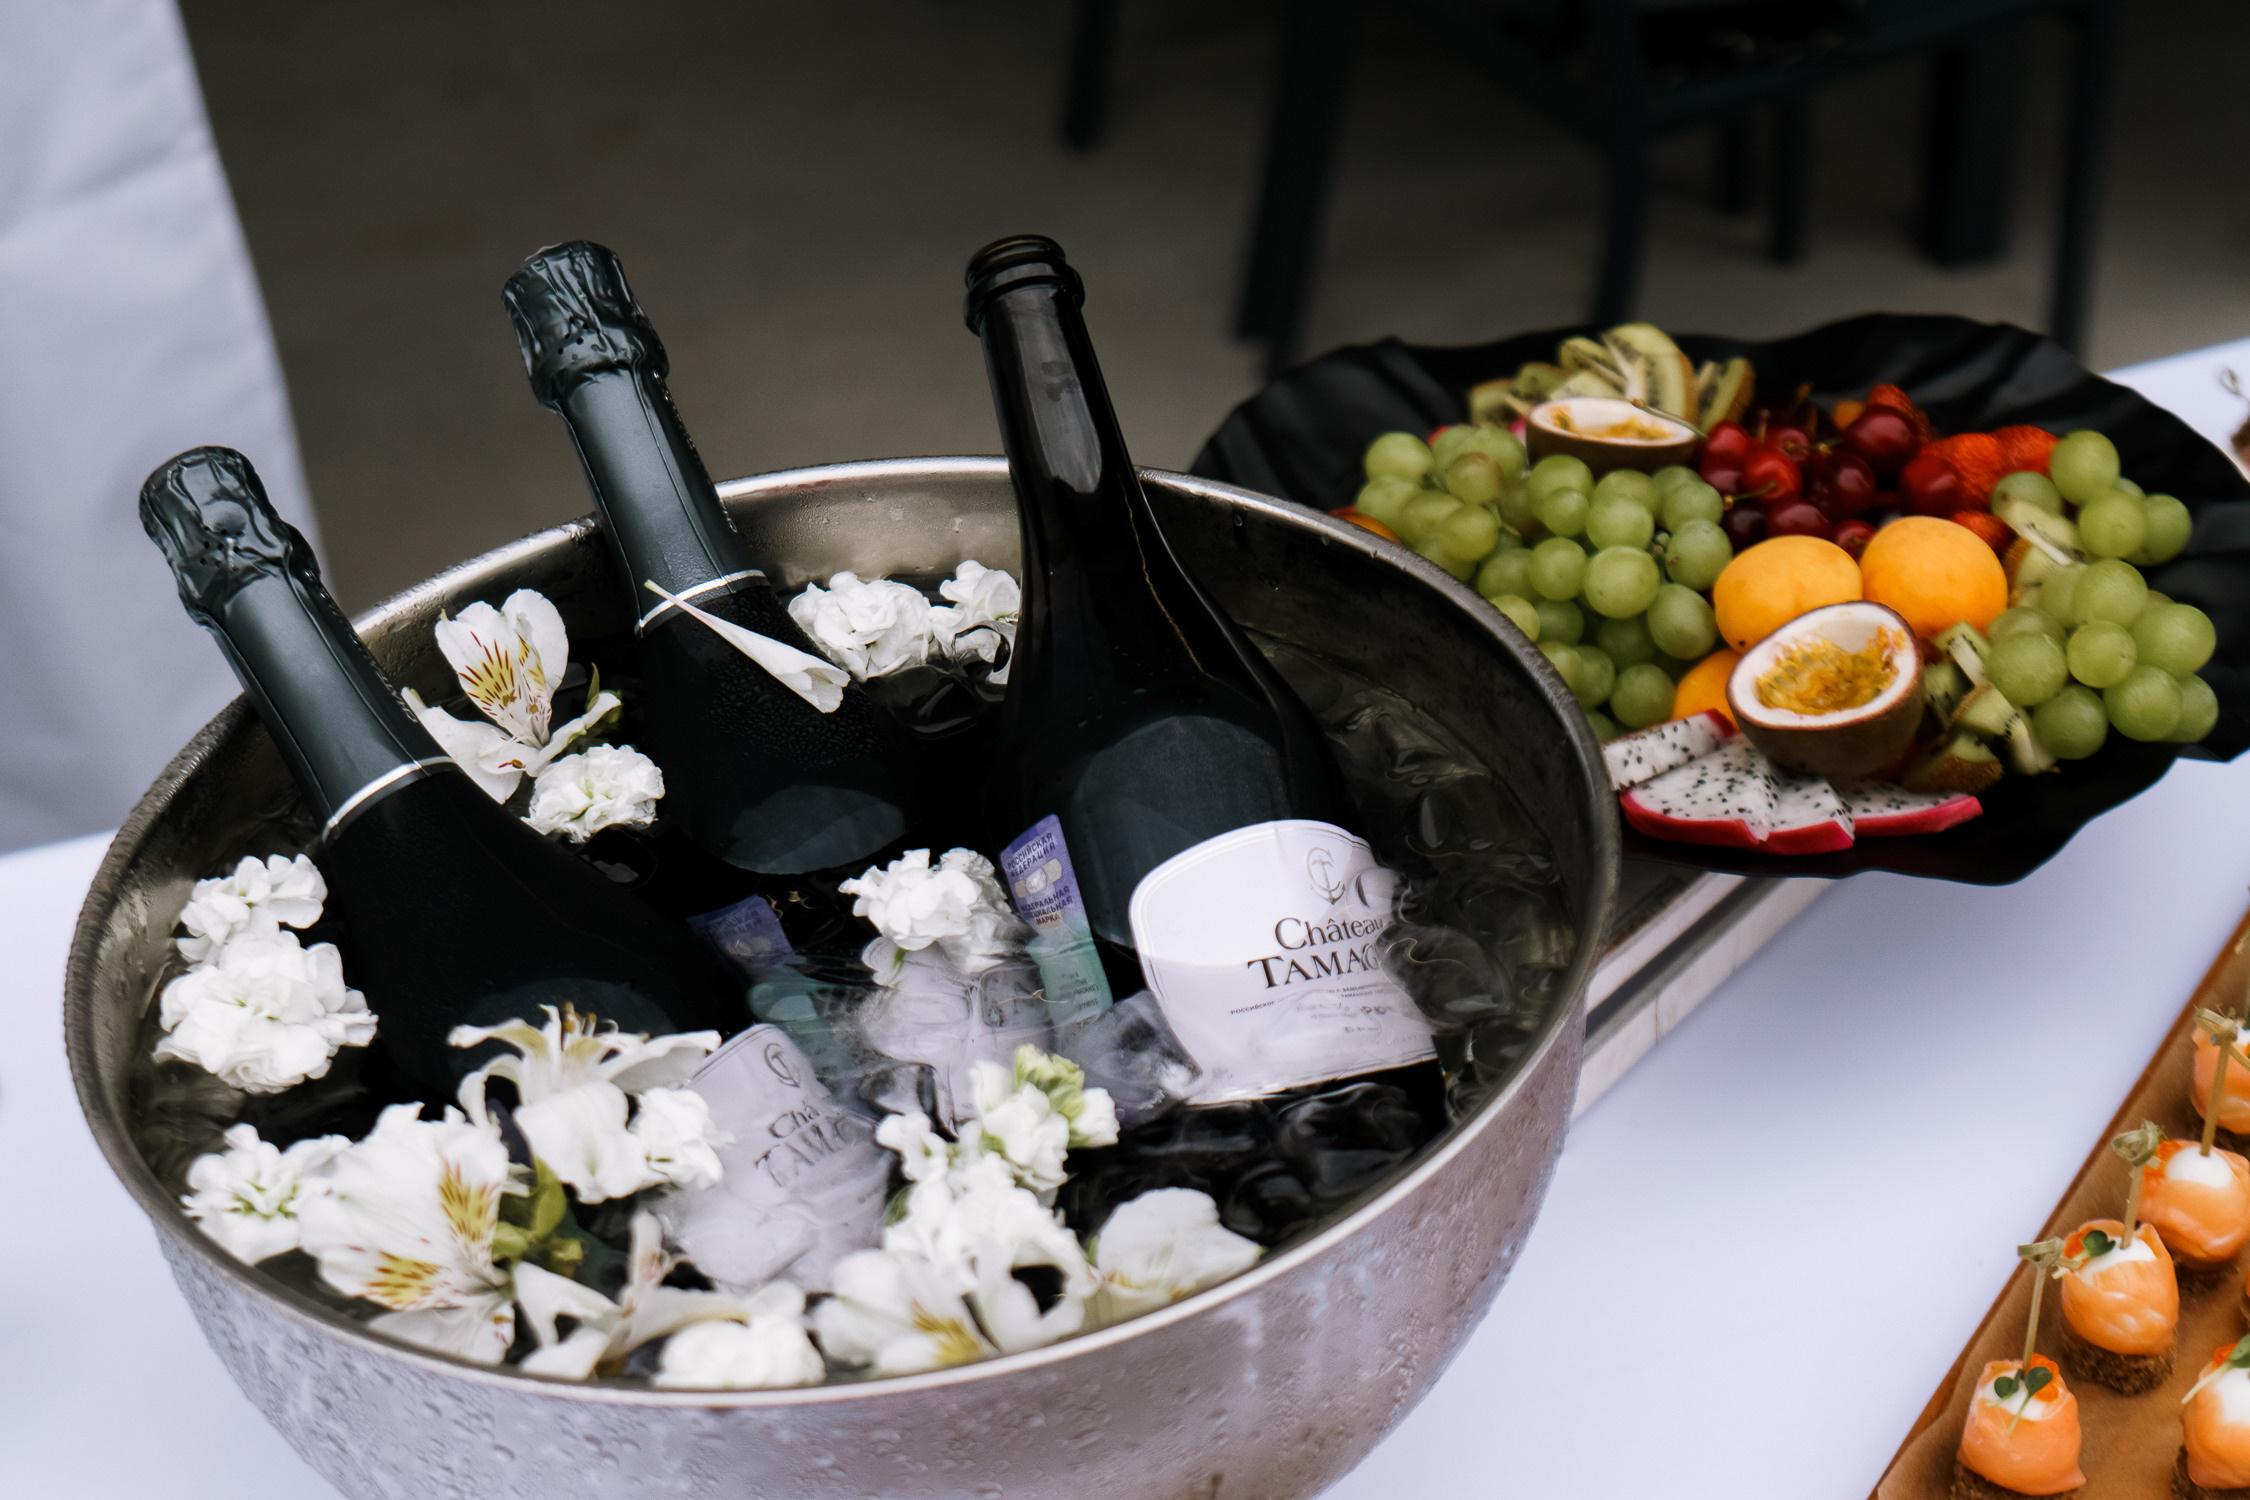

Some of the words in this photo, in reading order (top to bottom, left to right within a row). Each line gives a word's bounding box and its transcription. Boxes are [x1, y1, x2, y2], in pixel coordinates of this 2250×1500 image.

[1007, 832, 1053, 869] РОССИЙСКАЯ
[1009, 842, 1057, 877] ФЕДЕРАЦИЯ
[1021, 885, 1071, 912] ФЕДЕРАЛЬНАЯ
[1274, 916, 1385, 951] Château
